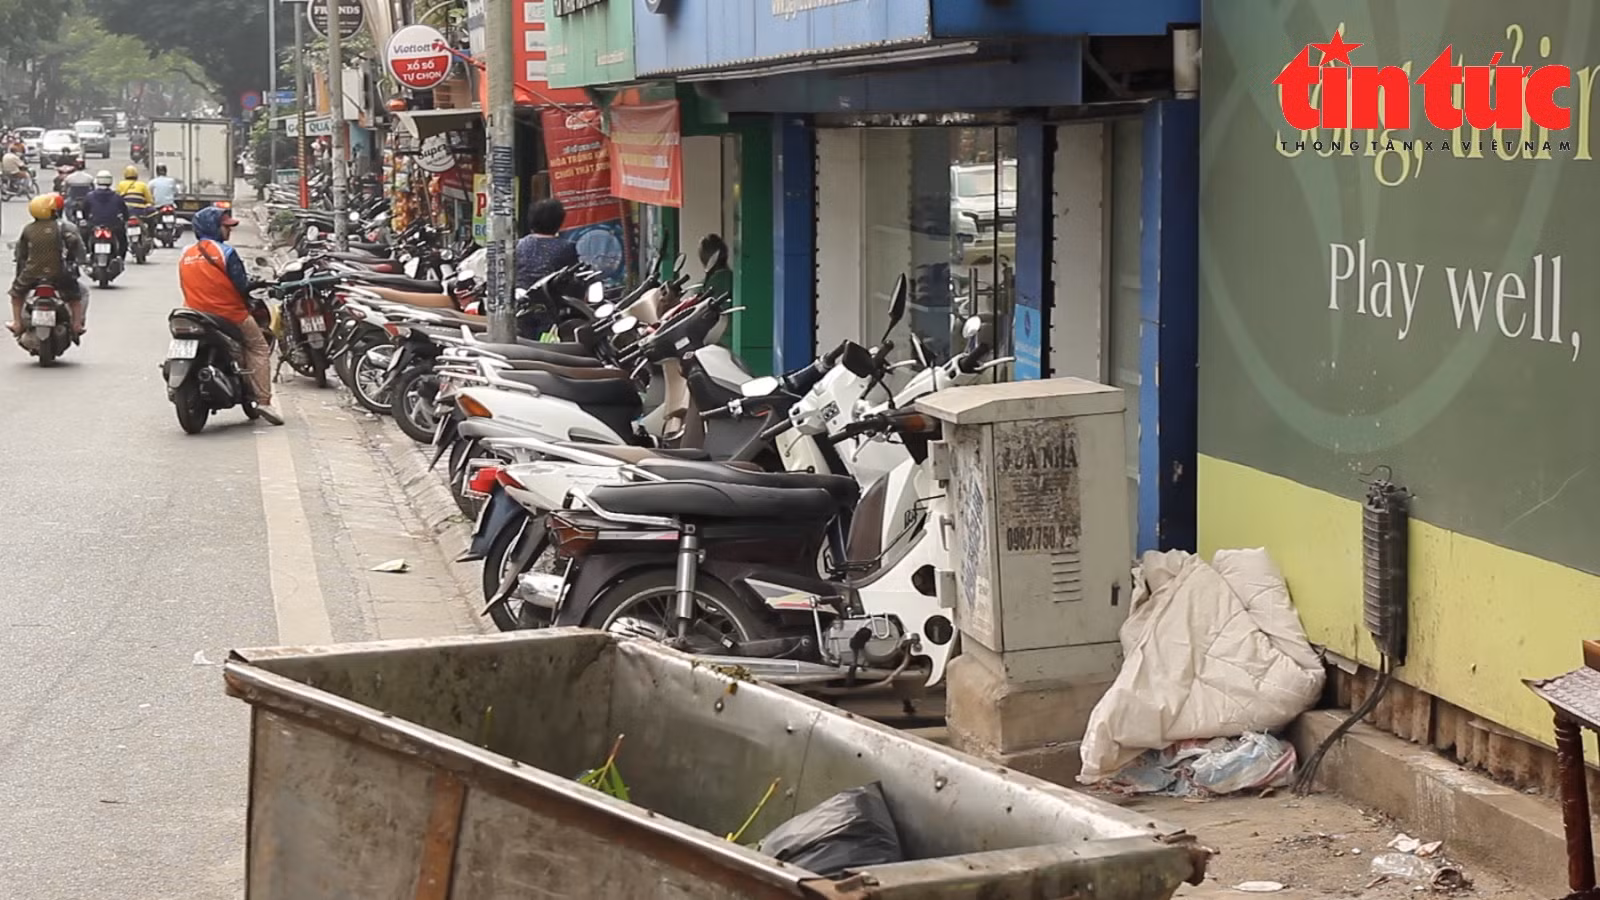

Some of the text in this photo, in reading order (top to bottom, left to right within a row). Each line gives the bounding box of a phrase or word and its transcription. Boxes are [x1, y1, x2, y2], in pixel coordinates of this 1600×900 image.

[313, 5, 361, 15] FRNDS
[393, 43, 431, 54] Vietlott
[1328, 238, 1581, 362] Play well,
